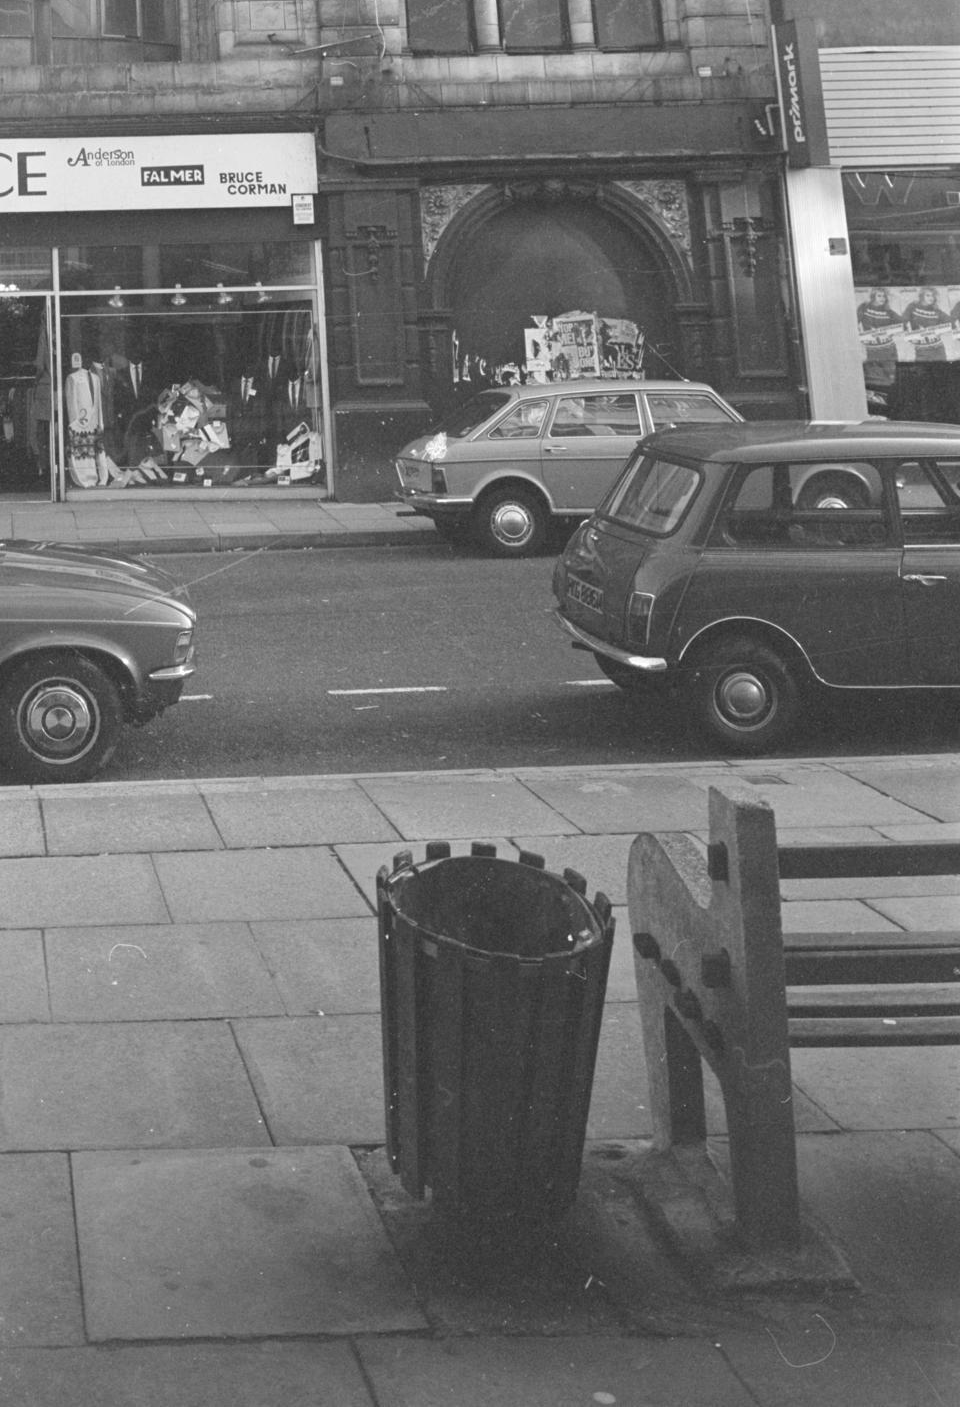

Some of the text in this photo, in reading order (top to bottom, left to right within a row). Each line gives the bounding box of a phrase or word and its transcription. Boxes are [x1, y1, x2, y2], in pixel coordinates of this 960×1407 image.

[783, 42, 806, 143] primark
[67, 147, 135, 167] Anderson
[143, 169, 202, 183] FALMER
[219, 172, 263, 184] BRUCE
[227, 184, 287, 195] CORMAN
